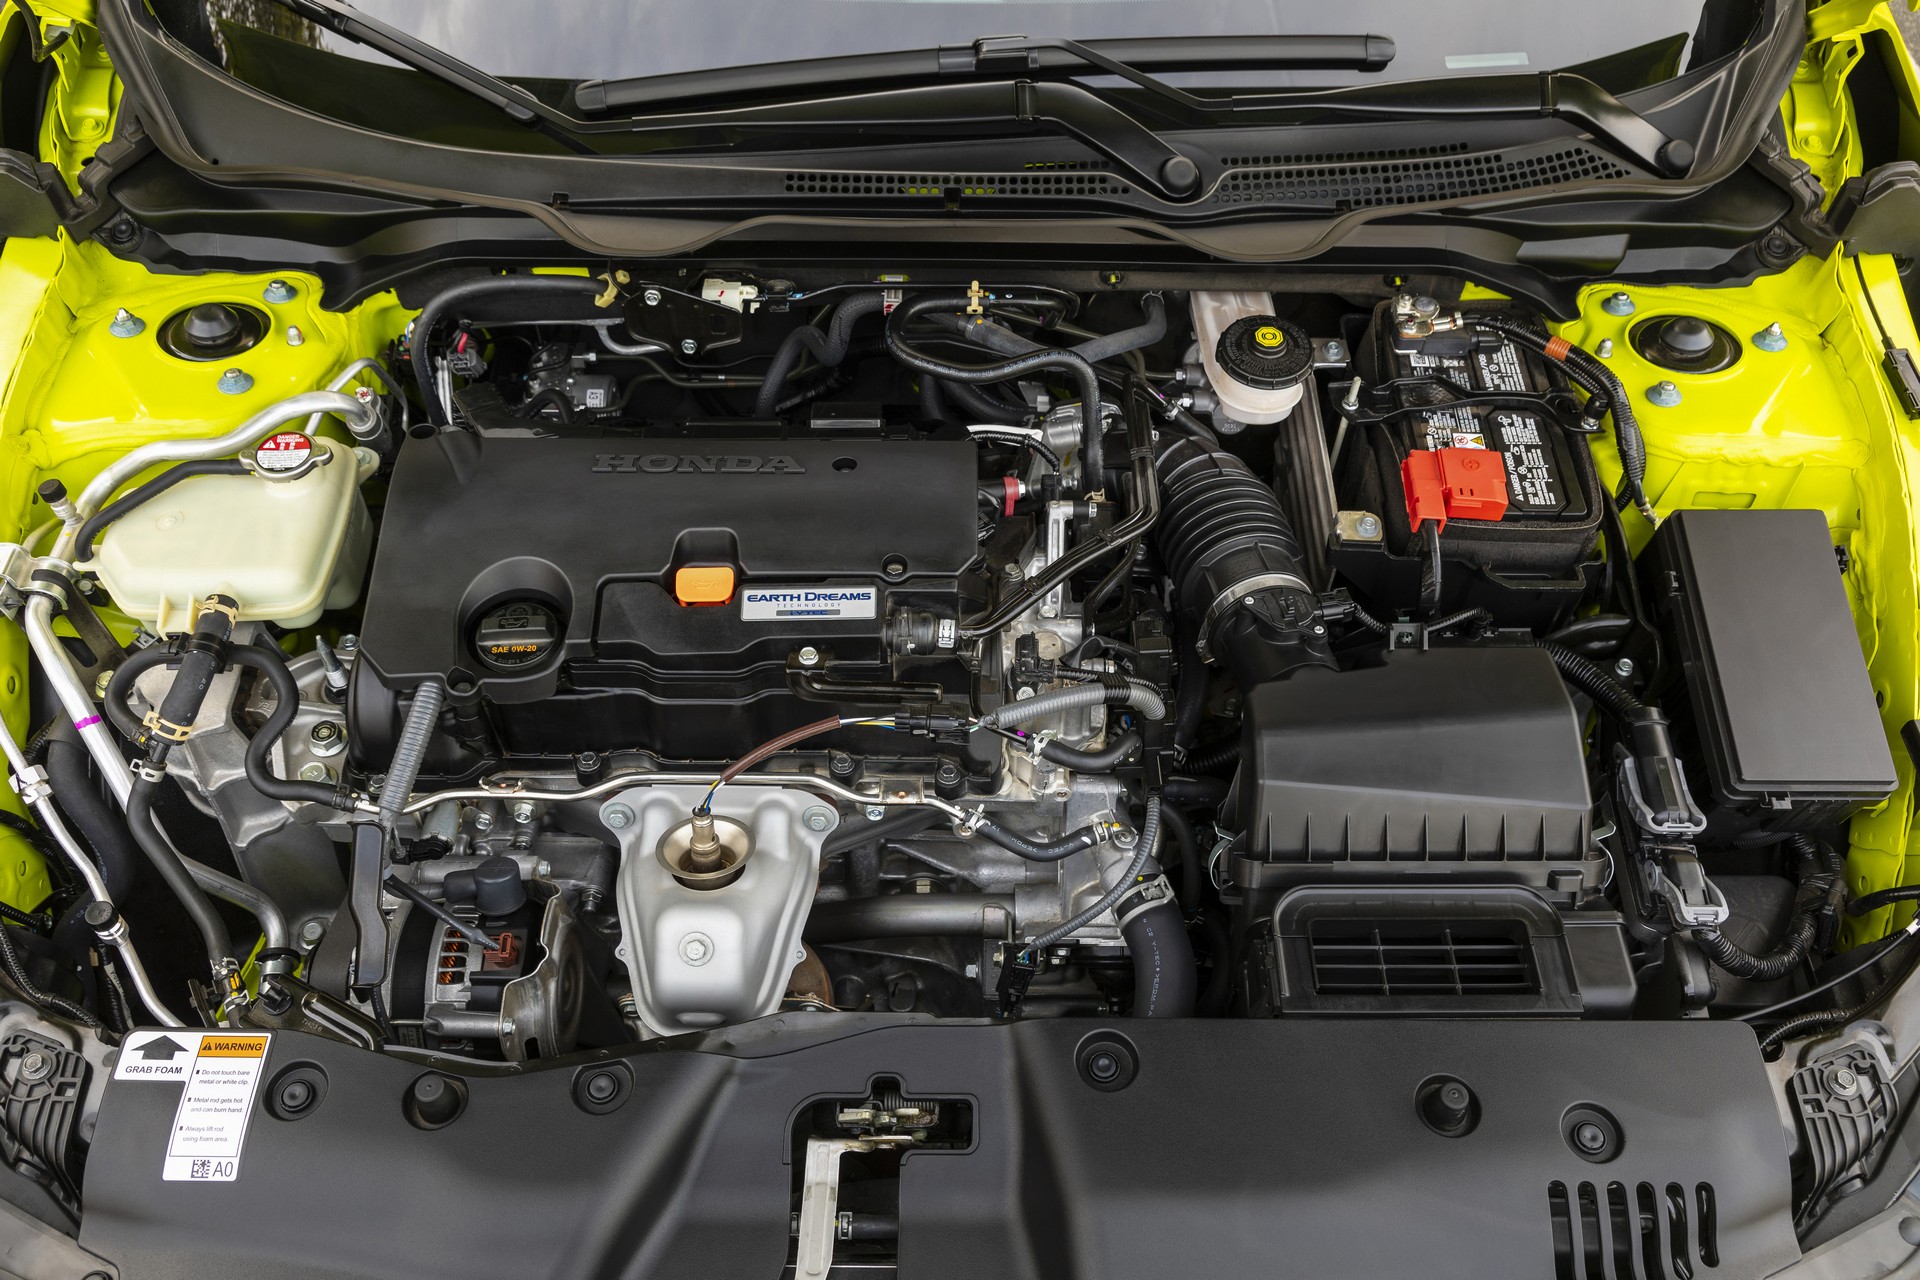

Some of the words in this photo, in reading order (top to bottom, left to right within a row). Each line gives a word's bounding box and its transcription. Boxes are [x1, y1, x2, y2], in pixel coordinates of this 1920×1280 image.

[592, 454, 806, 474] HONDA
[747, 593, 802, 602] EARTH
[804, 591, 872, 601] DREAMS
[491, 646, 509, 654] SAE
[511, 644, 537, 653] 0W-20
[214, 1042, 262, 1051] WARNING
[125, 1066, 152, 1074] GRAB
[155, 1066, 183, 1074] FOAM
[212, 1161, 234, 1177] A0
